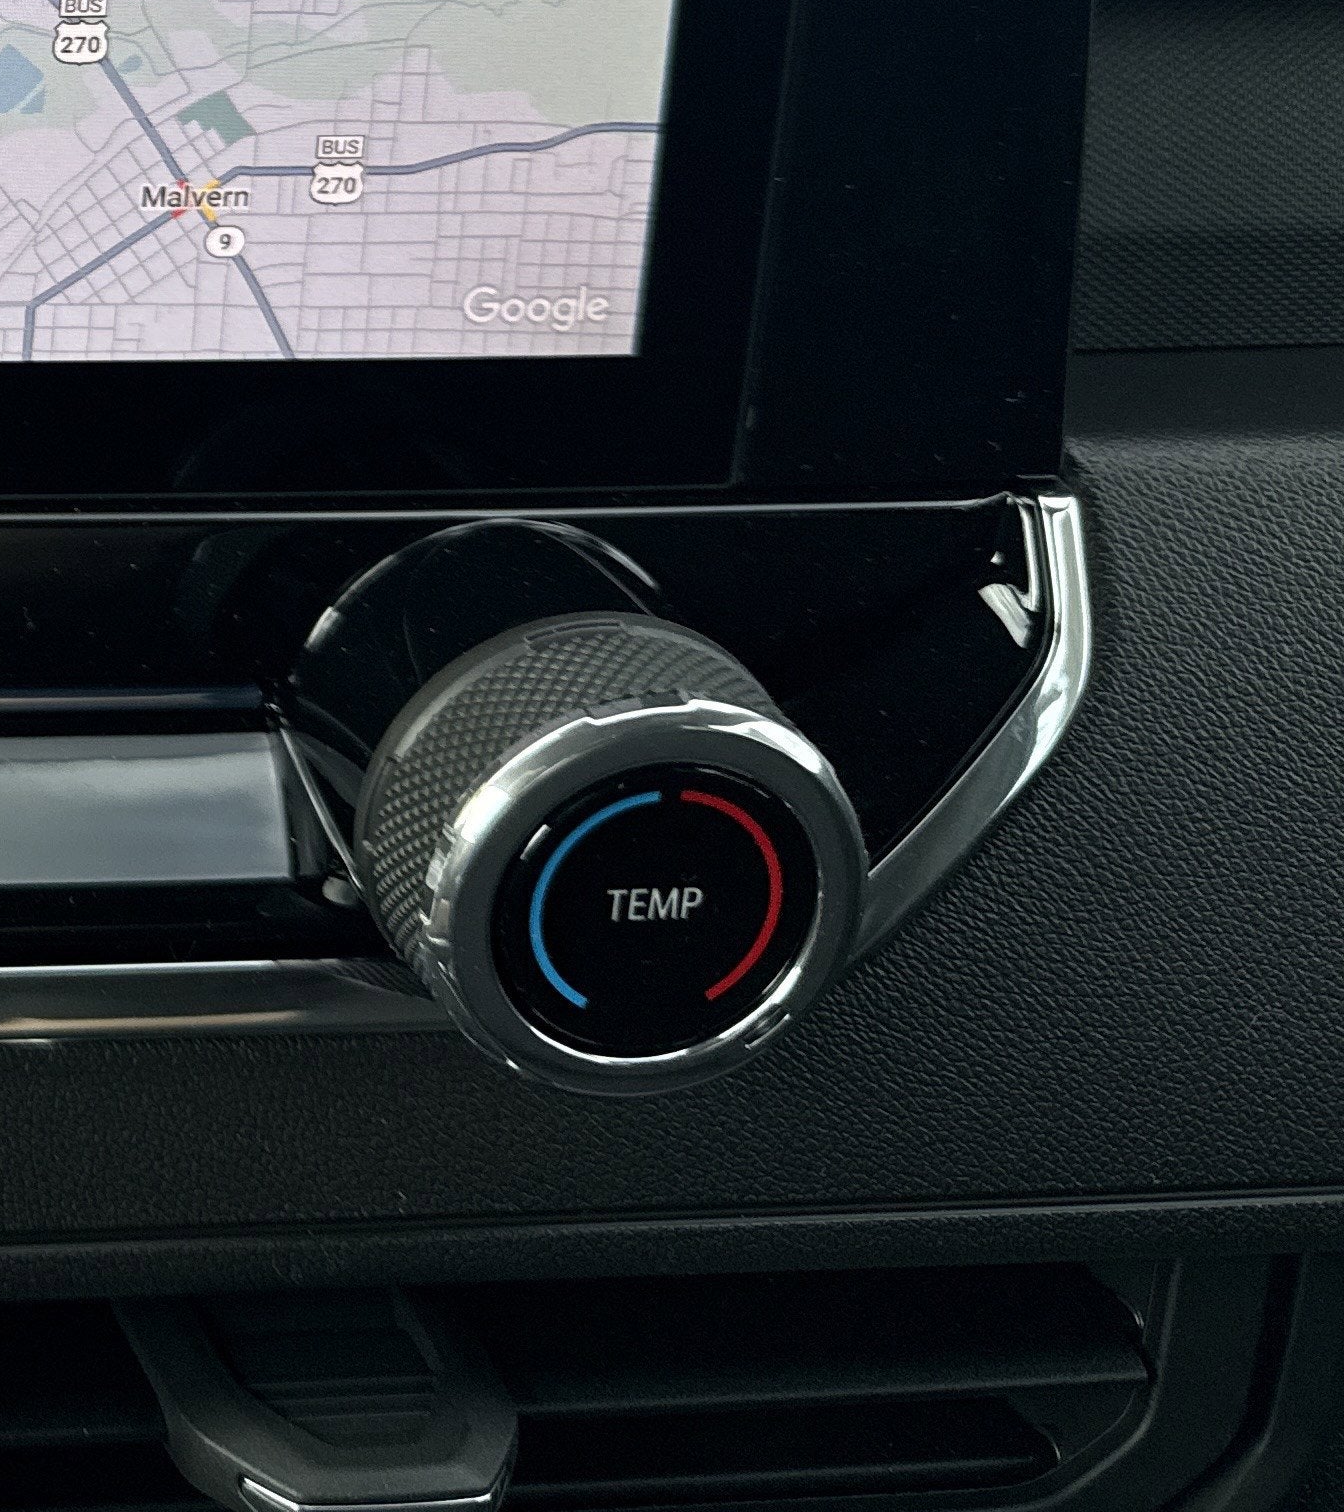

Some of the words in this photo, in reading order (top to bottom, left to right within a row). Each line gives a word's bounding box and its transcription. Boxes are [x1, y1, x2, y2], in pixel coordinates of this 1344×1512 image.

[60, 36, 101, 55] 270
[321, 138, 360, 157] BUS
[317, 177, 357, 195] 270
[141, 184, 250, 209] Malvern
[218, 233, 232, 250] 9
[463, 285, 610, 332] Google
[606, 887, 705, 922] TEMP
